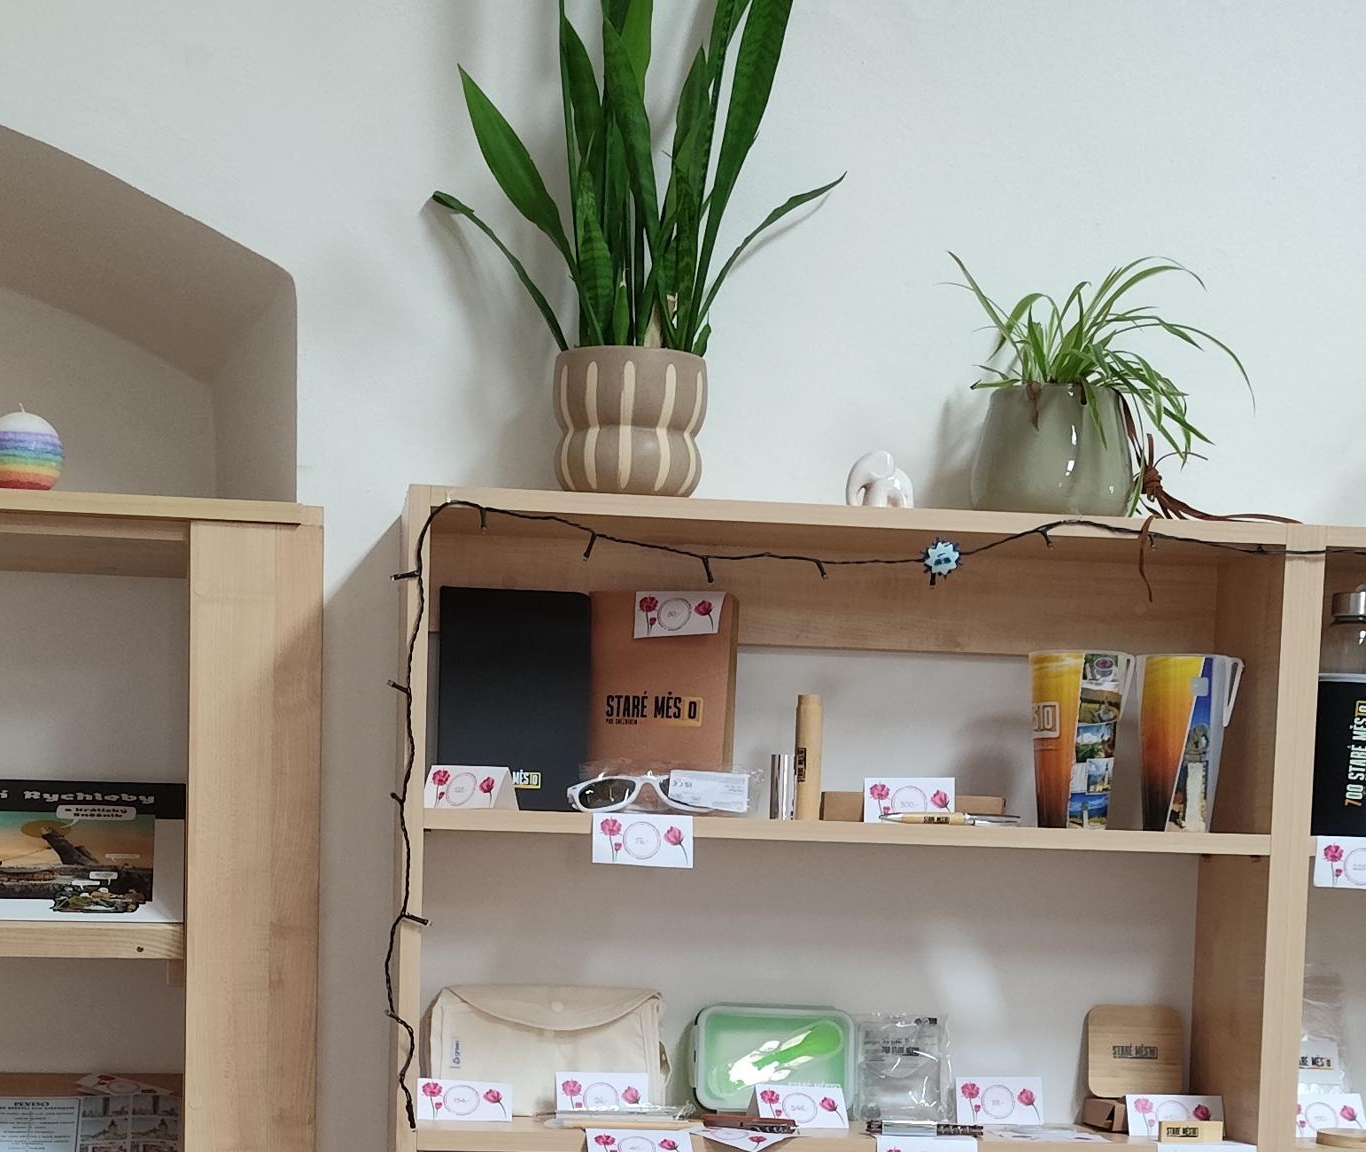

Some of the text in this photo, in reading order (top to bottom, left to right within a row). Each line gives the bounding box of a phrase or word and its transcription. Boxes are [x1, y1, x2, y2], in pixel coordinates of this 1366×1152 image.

[606, 691, 648, 718] STARÉ
[23, 790, 155, 804] Rychleby
[1344, 784, 1364, 806] 700
